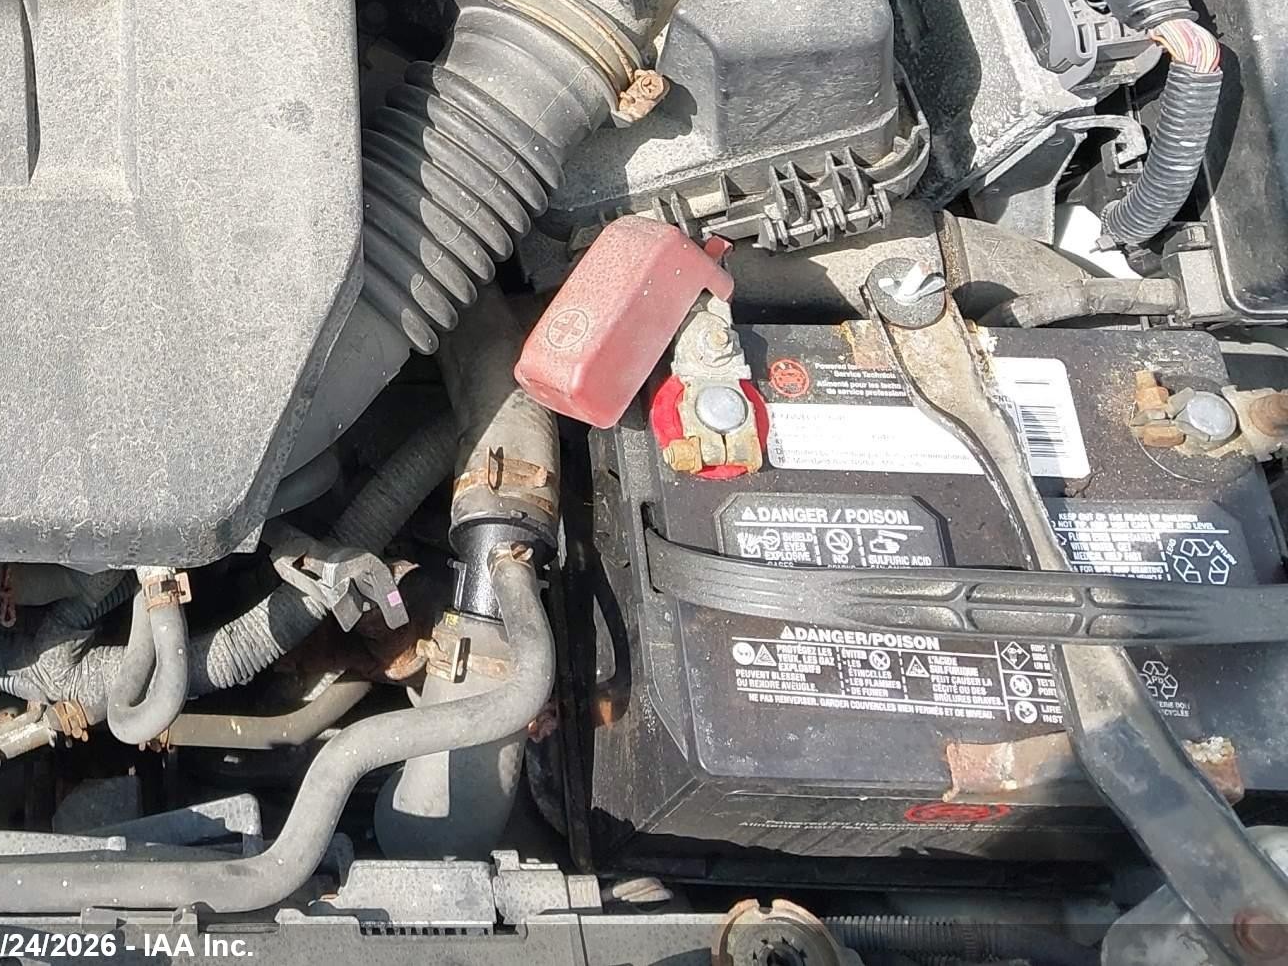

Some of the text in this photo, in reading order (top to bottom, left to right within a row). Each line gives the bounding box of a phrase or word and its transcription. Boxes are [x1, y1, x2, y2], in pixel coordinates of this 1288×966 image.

[757, 507, 828, 523] DANGER
[845, 509, 910, 525] POISON
[832, 554, 849, 564] NO
[868, 554, 932, 567] SULFURIC ACID
[793, 626, 941, 651] DANGER/POISON
